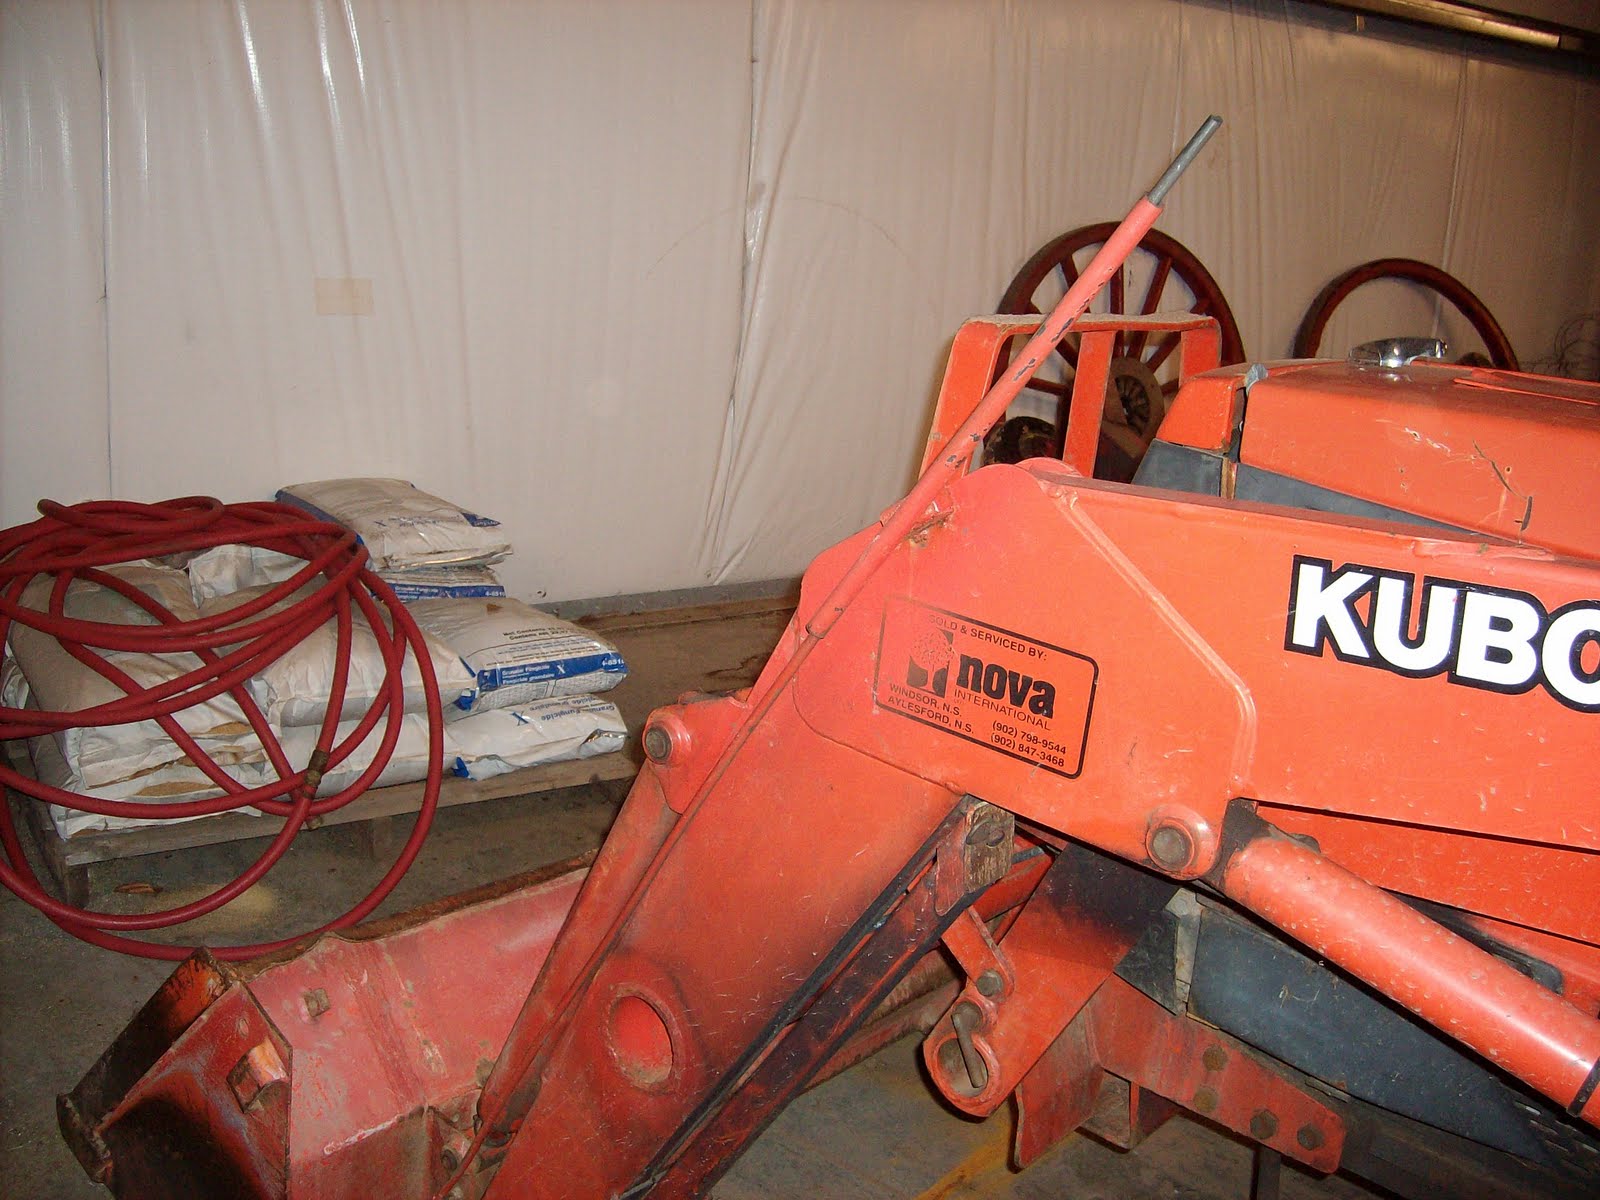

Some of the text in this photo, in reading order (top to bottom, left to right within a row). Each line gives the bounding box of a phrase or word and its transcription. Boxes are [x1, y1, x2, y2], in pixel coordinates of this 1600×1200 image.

[928, 614, 1048, 661] SOLD & SERVICED BY:
[1284, 554, 1600, 714] KUBO
[956, 654, 1056, 719] nova
[888, 696, 974, 734] AYLESFORD, N.S.
[942, 700, 962, 717] N.S.
[953, 688, 1051, 731] INTERNATIONAL
[990, 733, 1065, 767] (902) 847-3468
[992, 720, 1067, 755] (902) 798-9544
